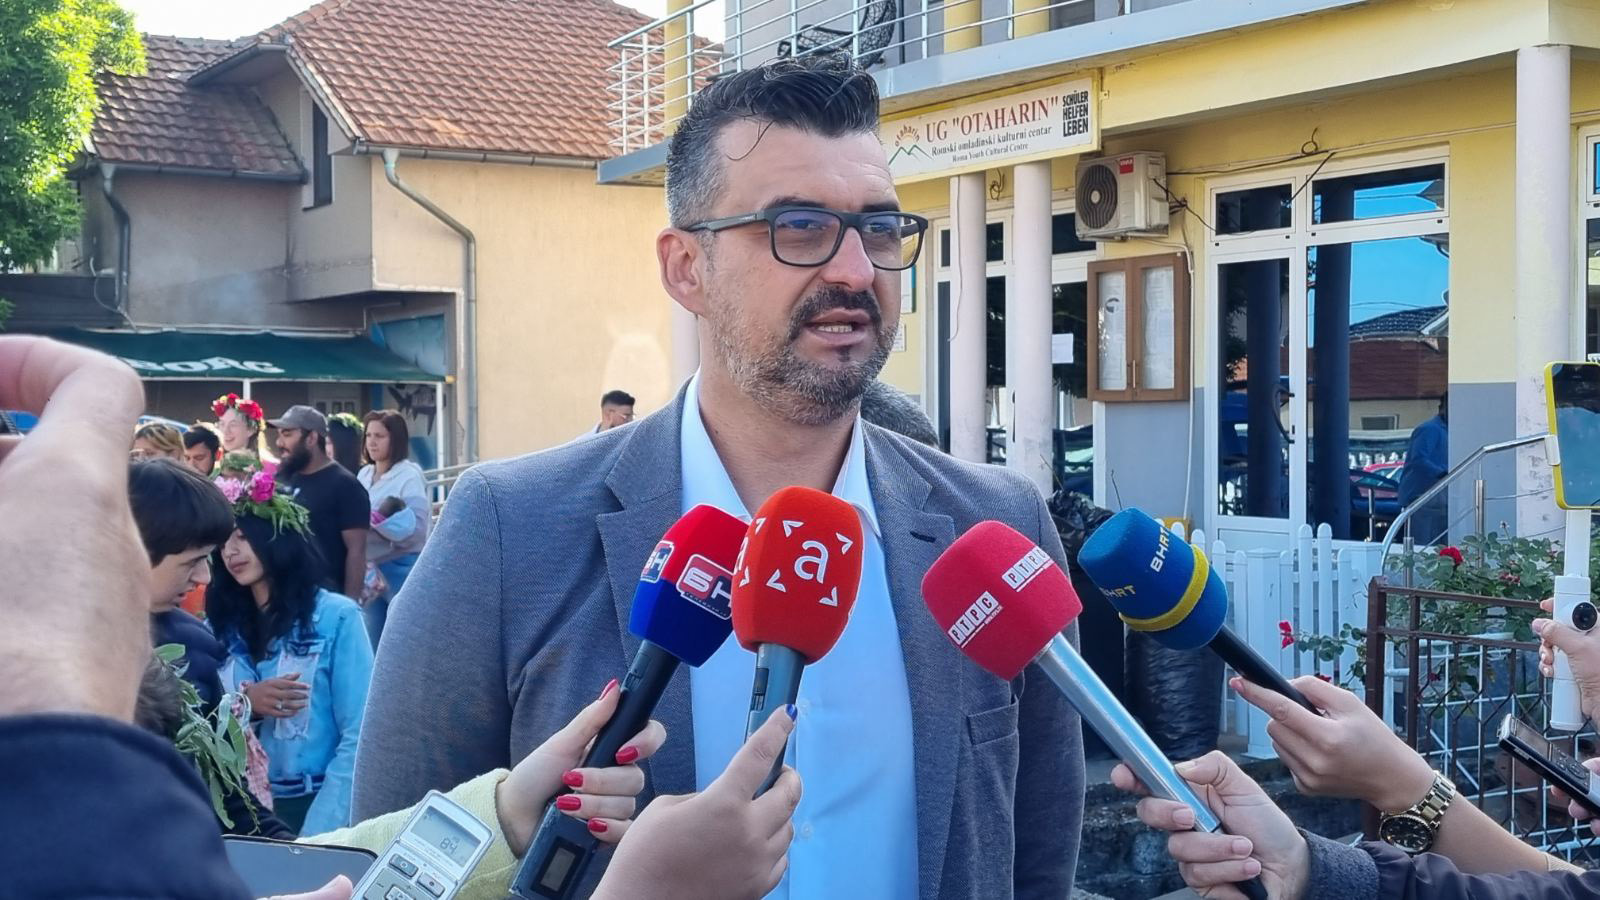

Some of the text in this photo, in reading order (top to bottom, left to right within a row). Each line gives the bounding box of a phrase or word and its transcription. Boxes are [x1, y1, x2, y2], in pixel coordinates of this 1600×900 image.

[1062, 90, 1088, 107] SCHÜLER
[926, 96, 1058, 143] UG "OTAHARIN"
[1062, 103, 1088, 120] HELFEN
[957, 133, 996, 151] omladinski
[997, 128, 1026, 144] kulturni
[1028, 126, 1053, 138] centar
[1063, 118, 1088, 137] LEBEN
[794, 540, 829, 584] a
